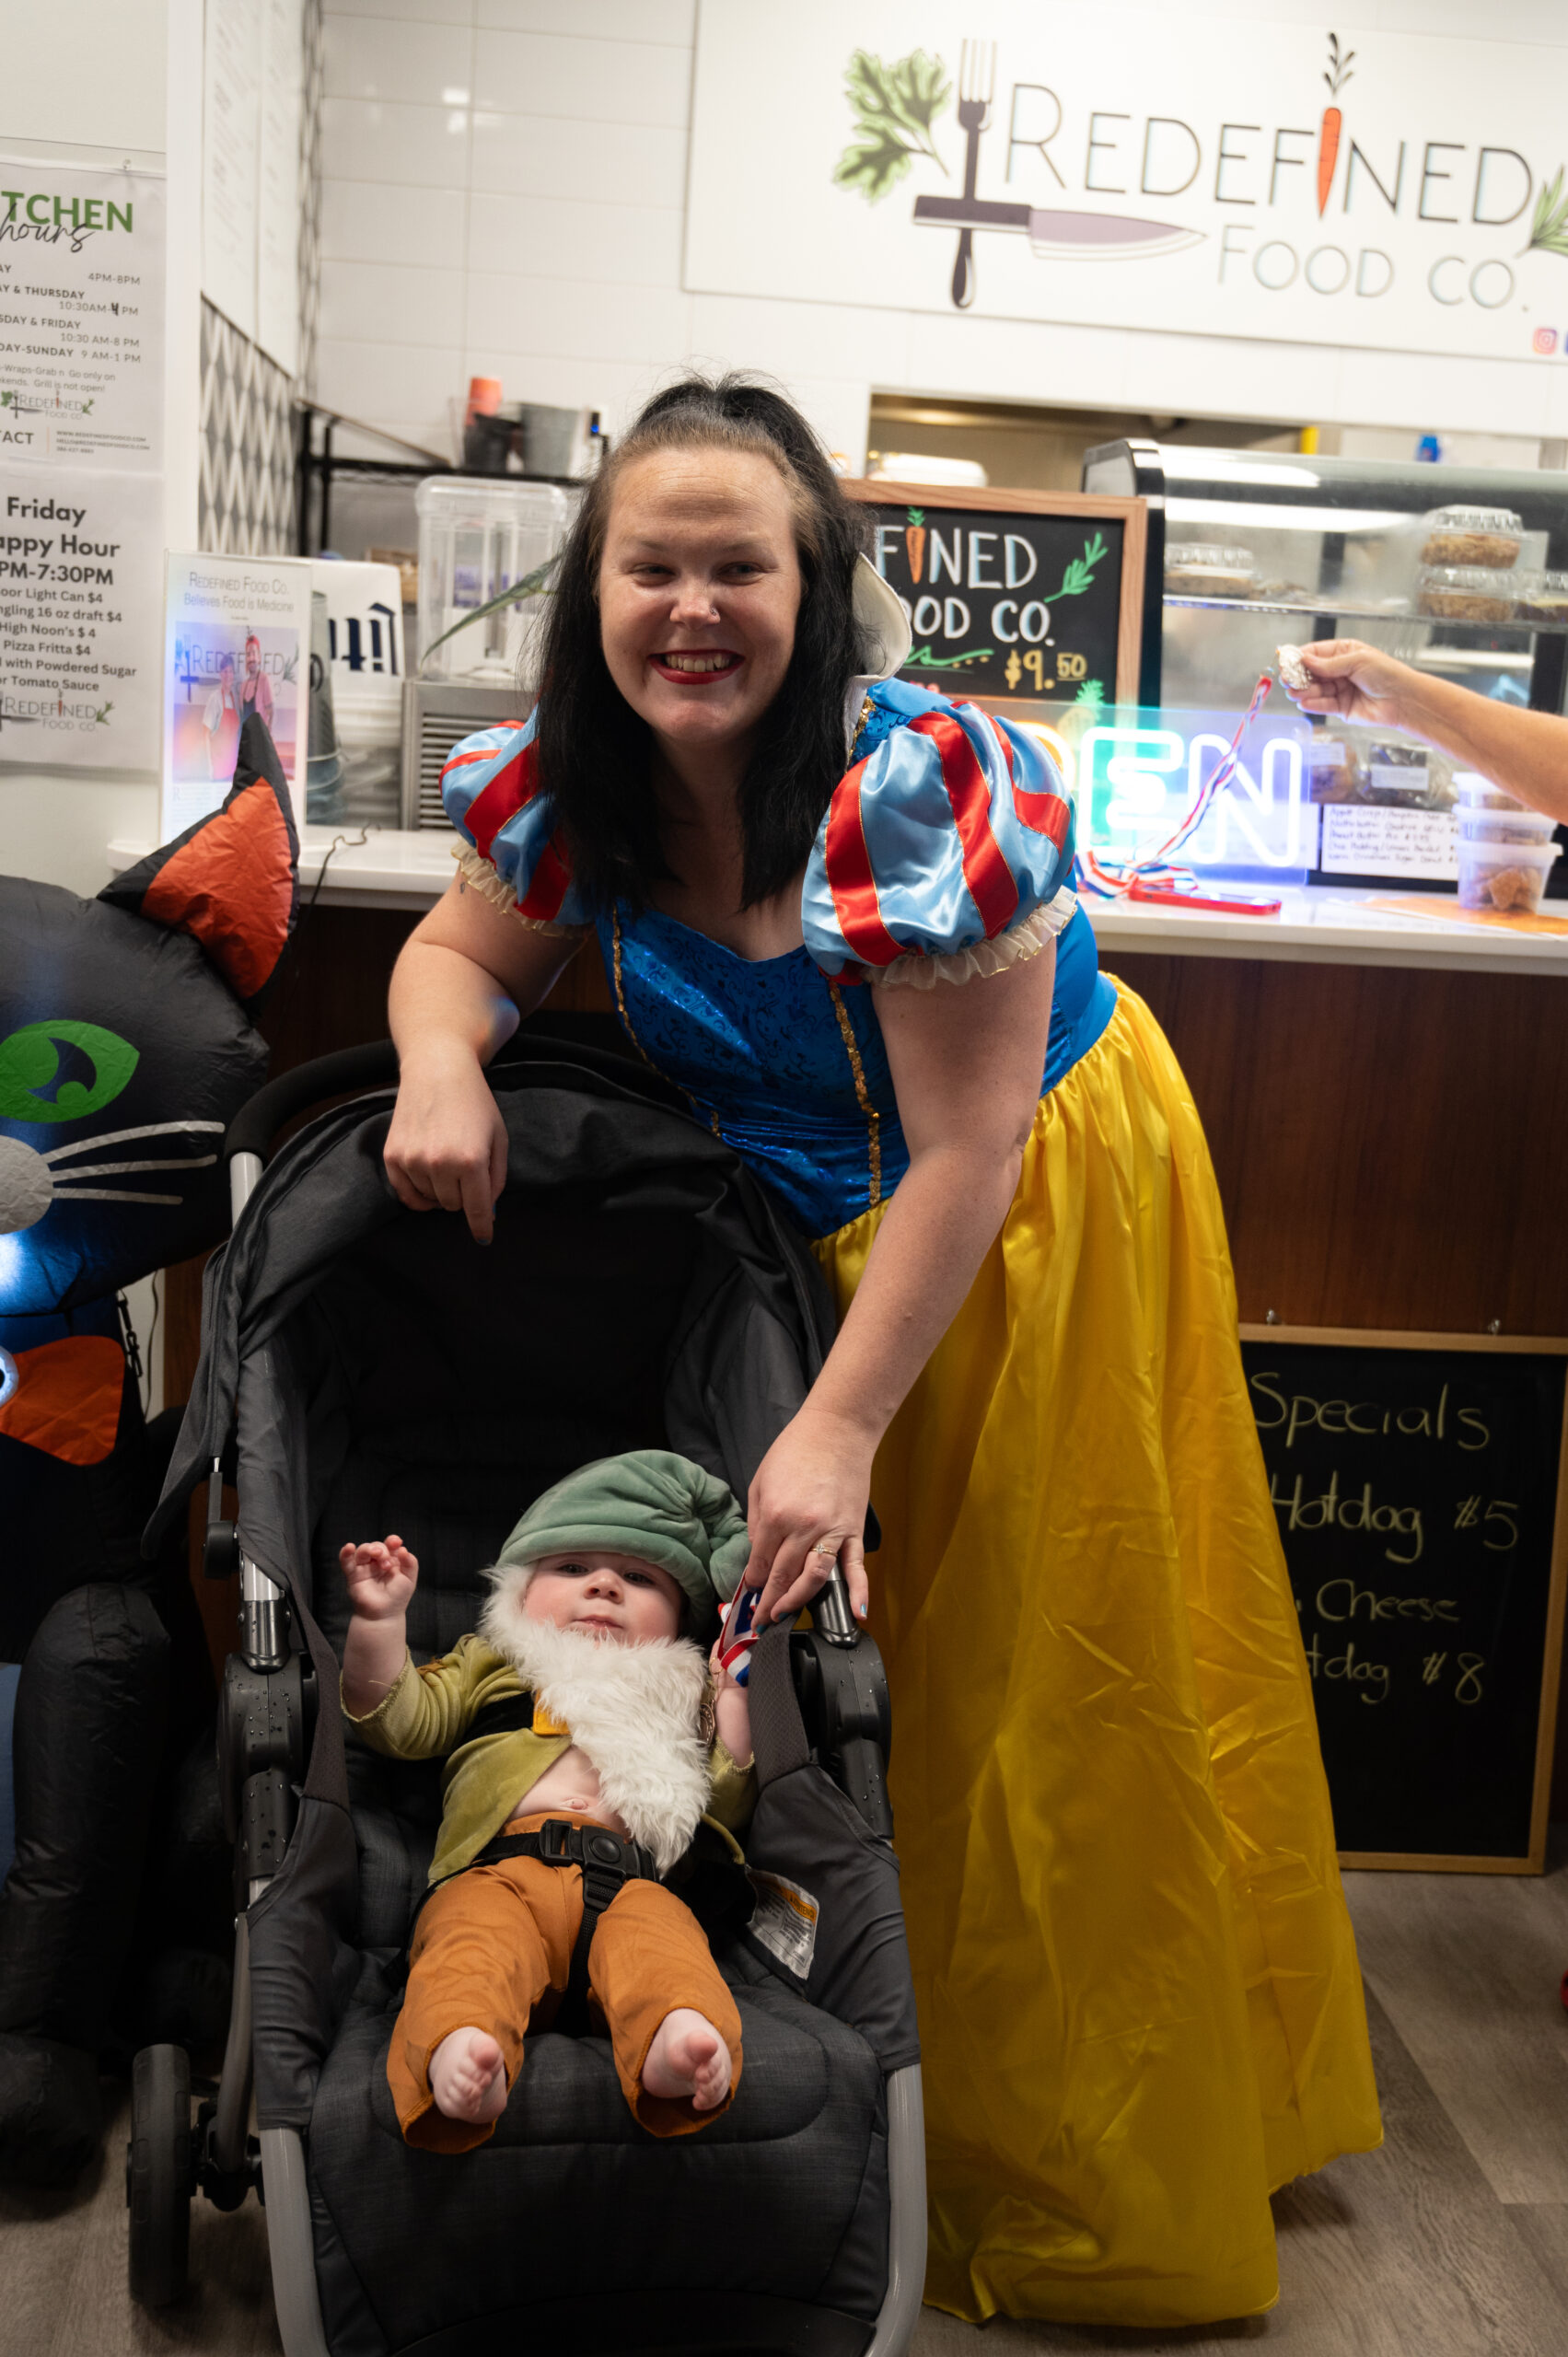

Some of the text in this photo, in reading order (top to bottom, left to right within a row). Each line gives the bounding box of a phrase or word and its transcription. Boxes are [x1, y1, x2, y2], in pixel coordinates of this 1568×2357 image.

[1005, 81, 1534, 226] REDEFINED
[0, 202, 96, 253] hours
[1218, 223, 1530, 313] FOOD CO.
[88, 273, 141, 285] 4PM-8PM
[14, 285, 21, 294] &
[25, 286, 85, 299] THURSDAY
[122, 306, 139, 316] PM
[30, 317, 38, 326] &
[41, 318, 81, 330] FRIDAY
[61, 332, 140, 348] 10:30 AM-8 PM
[81, 350, 87, 359] 9
[91, 351, 120, 362] AM-1
[124, 354, 141, 364] PM
[69, 369, 82, 378] Go
[83, 371, 102, 382] only
[104, 373, 116, 381] on
[34, 378, 52, 388] Grill
[54, 380, 62, 389] is
[64, 381, 78, 390] not
[80, 383, 105, 393] open!
[7, 495, 87, 528] Friday
[61, 533, 122, 558] Hour
[190, 572, 239, 592] REDEFINED
[26, 587, 57, 602] Light
[61, 590, 85, 602] Can
[87, 592, 103, 604] $4
[184, 593, 295, 612] Believes Food is Medicine
[38, 607, 52, 618] 16
[55, 610, 69, 620] oz
[73, 610, 104, 621] draft
[107, 610, 122, 623] $4
[906, 595, 1055, 647] OD CO.
[0, 621, 97, 639] High Noon's $ 4
[4, 640, 91, 656] Pizza Fritta $4
[6, 657, 33, 669] with
[36, 659, 99, 674] Powdered
[101, 664, 137, 679] Sugar
[1004, 648, 1087, 691] $9.50
[12, 675, 59, 689] Tomato
[62, 679, 99, 691] Sauce
[5, 696, 97, 719] REDEFINED
[42, 718, 75, 731] FOOD
[1251, 1372, 1490, 1450] Specials
[1454, 1494, 1519, 1550] $5
[1316, 1578, 1460, 1621] Cheese
[1423, 1652, 1485, 1703] $8
